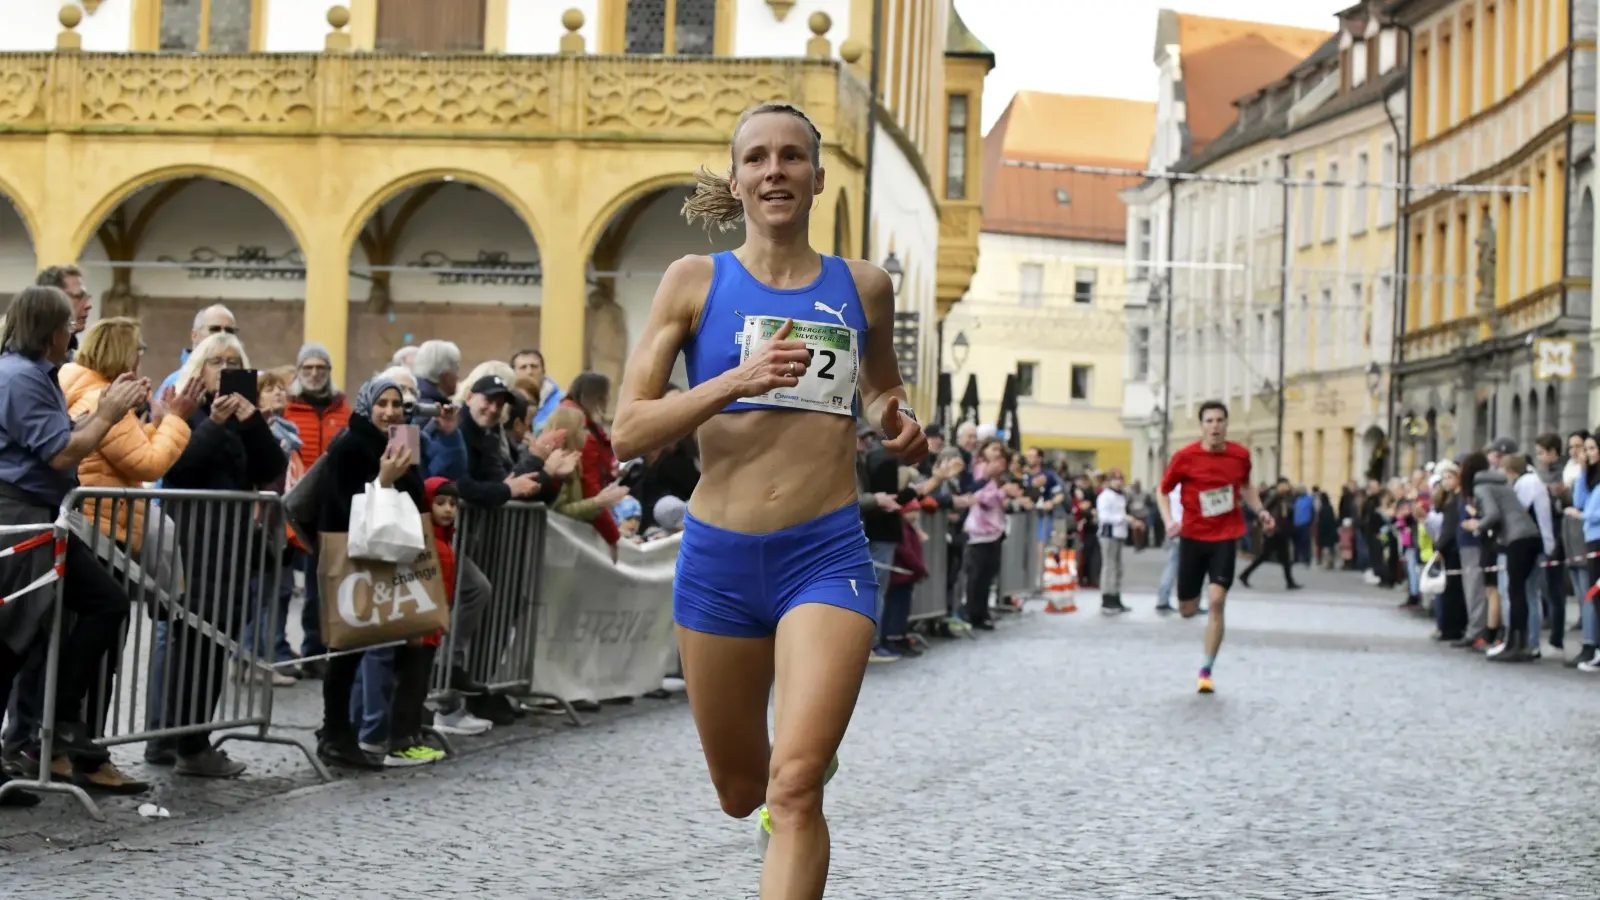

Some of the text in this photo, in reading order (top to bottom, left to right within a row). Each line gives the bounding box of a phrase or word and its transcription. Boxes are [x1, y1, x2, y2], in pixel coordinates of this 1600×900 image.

[791, 325, 827, 335] MBERGER
[806, 348, 837, 380] 2
[392, 566, 437, 586] change
[337, 564, 438, 627] C&A
